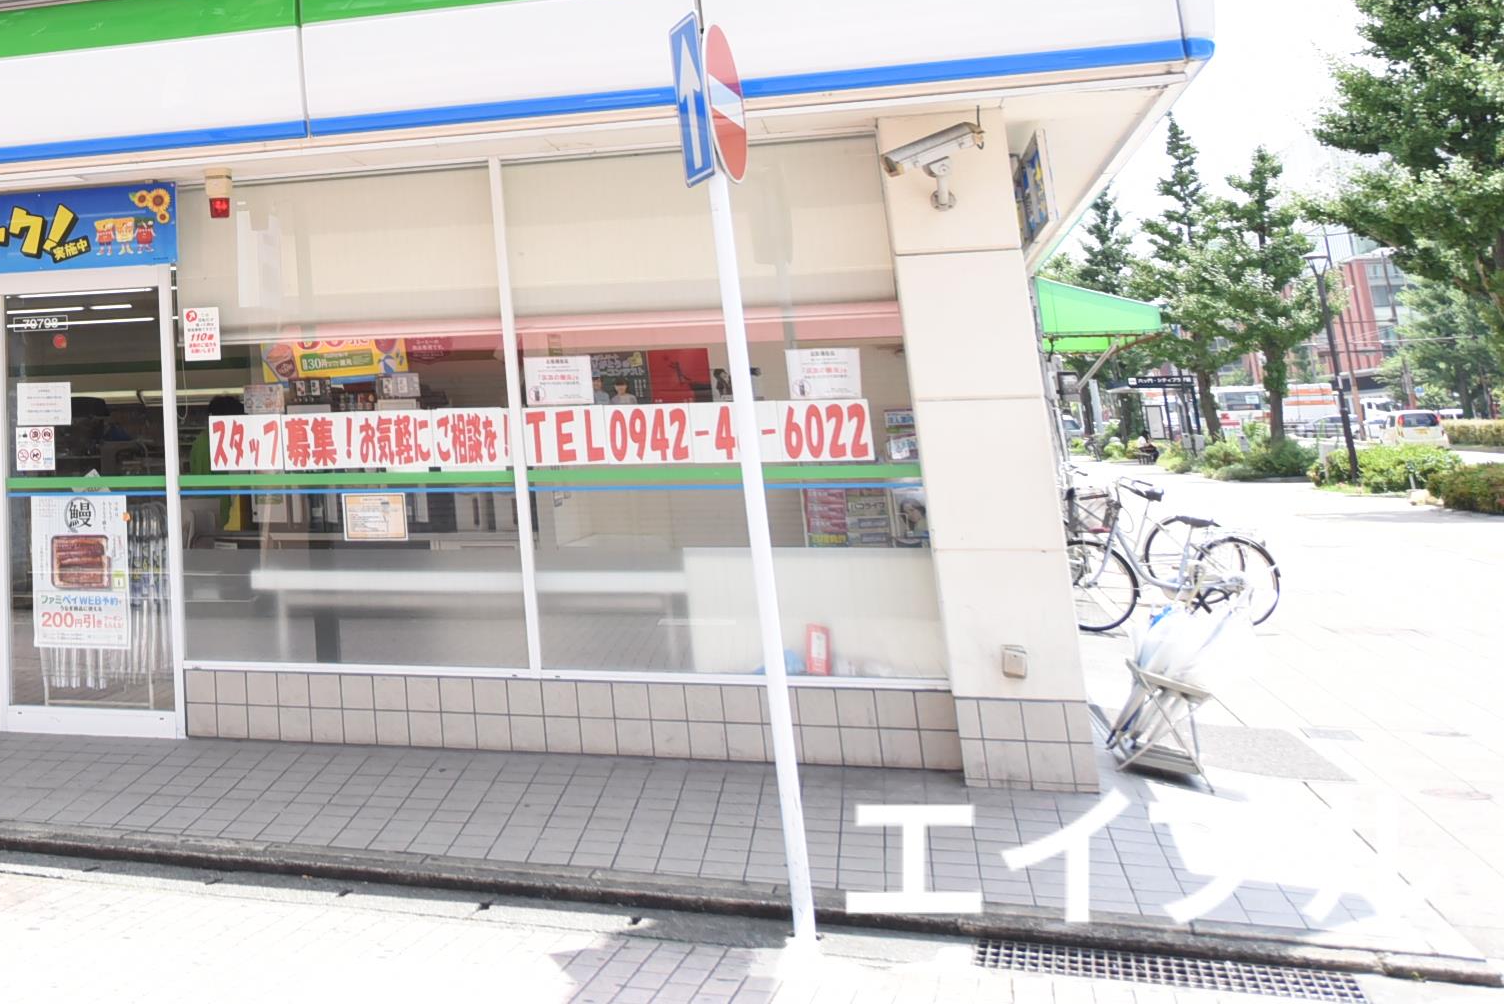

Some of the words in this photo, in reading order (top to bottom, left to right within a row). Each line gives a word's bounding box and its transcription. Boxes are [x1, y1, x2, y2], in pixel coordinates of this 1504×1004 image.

[52, 238, 90, 262] 実施中
[69, 502, 92, 528] 鰻
[41, 611, 103, 629] 200円引き
